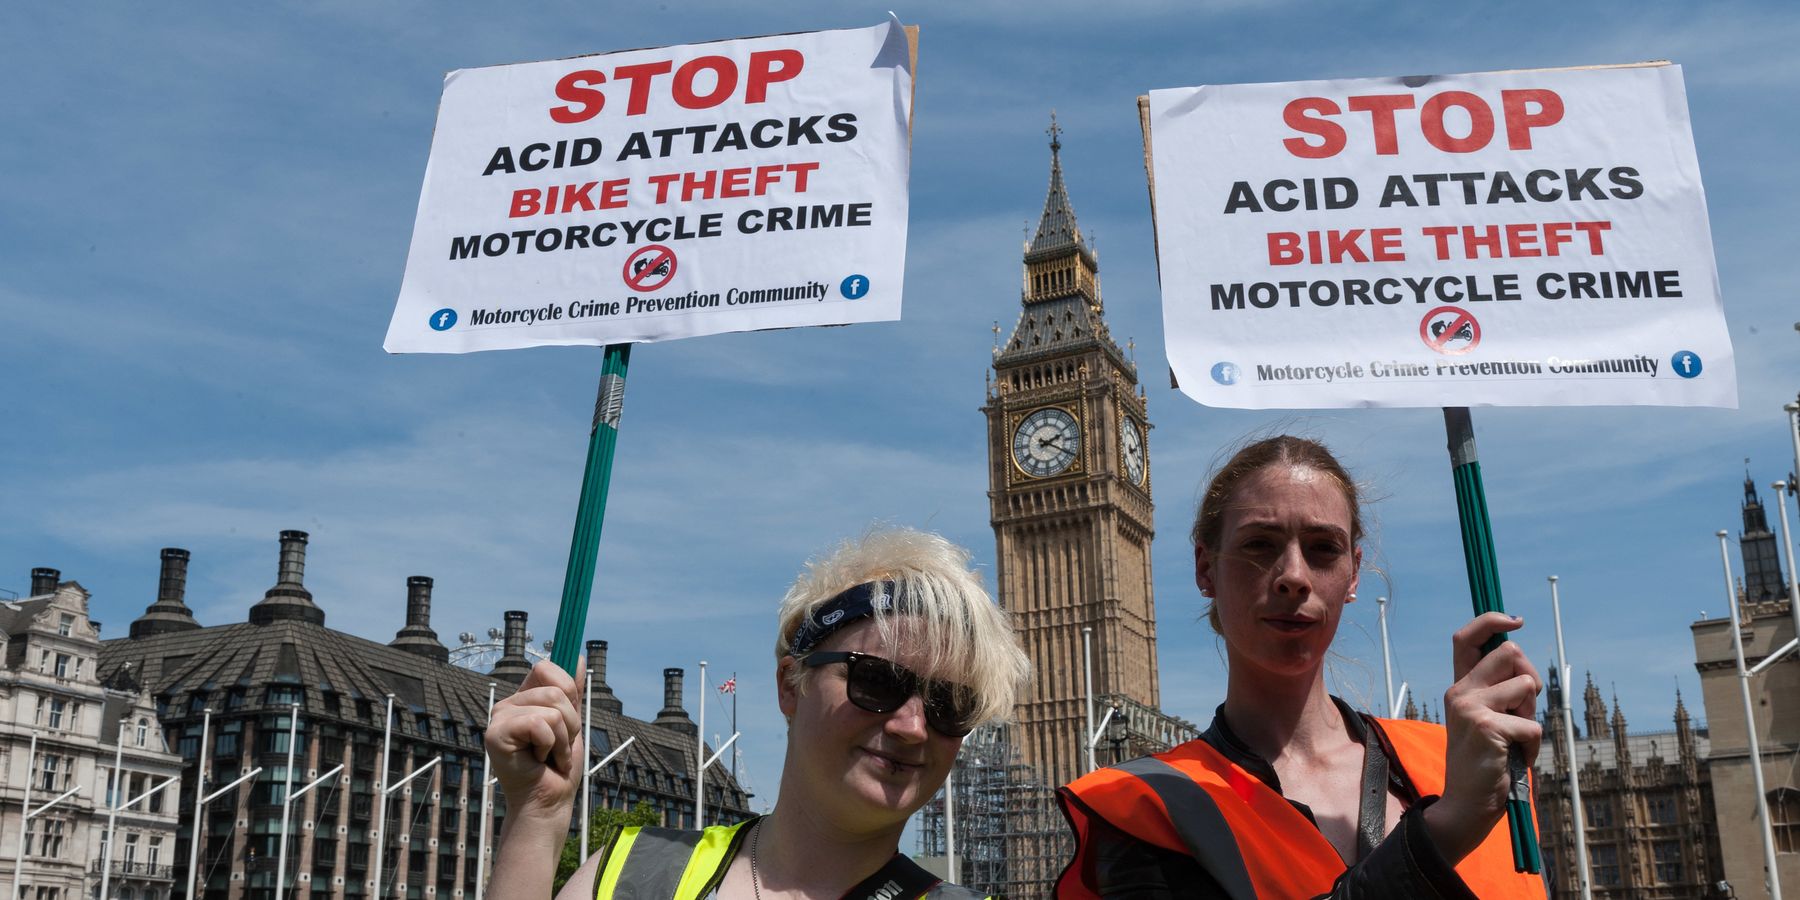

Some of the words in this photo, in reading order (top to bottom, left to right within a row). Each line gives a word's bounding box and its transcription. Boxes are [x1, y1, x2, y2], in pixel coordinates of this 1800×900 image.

[549, 49, 804, 124] STOP
[482, 137, 603, 177] ACID
[616, 112, 858, 162] ATTACKS
[1283, 89, 1565, 159] STOP
[509, 178, 630, 218] BIKE
[649, 162, 820, 205] THEFT
[1223, 177, 1359, 215] ACID
[1378, 166, 1644, 208] ATTACKS
[449, 209, 723, 261] MOTORCYCLE
[738, 202, 873, 235] CRIME
[1267, 228, 1405, 266] BIKE
[1423, 221, 1611, 260] THEFT
[469, 303, 563, 327] Motorcycle
[568, 299, 620, 319] Crime
[625, 290, 720, 314] Prevention
[726, 280, 829, 306] Community
[1210, 273, 1522, 311] MOTORCYCLE
[1536, 270, 1683, 300] CRIME
[1256, 361, 1364, 382] Motorcycle
[1369, 360, 1430, 378] Crime
